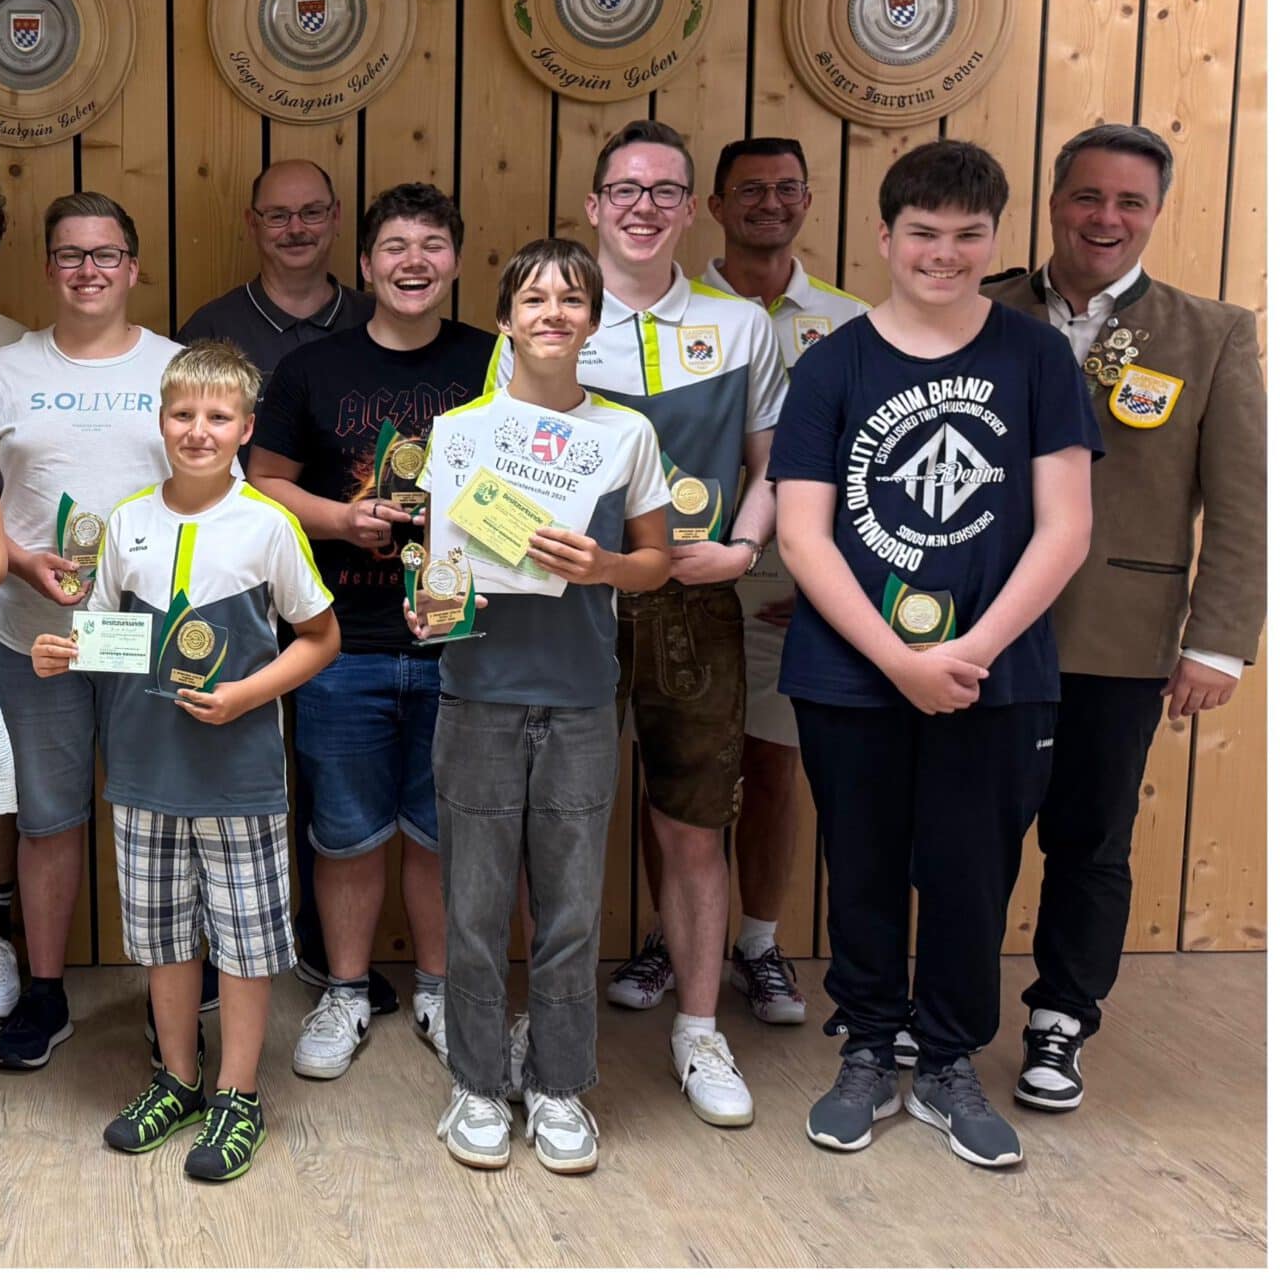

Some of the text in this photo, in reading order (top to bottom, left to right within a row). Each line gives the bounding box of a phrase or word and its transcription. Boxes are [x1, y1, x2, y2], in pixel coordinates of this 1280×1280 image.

[230, 51, 265, 94] Sieger
[816, 52, 859, 94] Sieger
[30, 392, 153, 412] S.OLIVER
[867, 386, 927, 435] DENIM
[928, 376, 994, 404] BRAND
[875, 415, 919, 464] ESTABLISHED
[918, 410, 938, 424] TWO
[981, 410, 1008, 437] SEVEN
[495, 457, 579, 493] URKUNDE
[847, 430, 879, 510] QUALITY
[935, 462, 1005, 487] Denim
[853, 507, 923, 572] ORIGINAL
[896, 510, 995, 547] CHERISHED NEW GOODS
